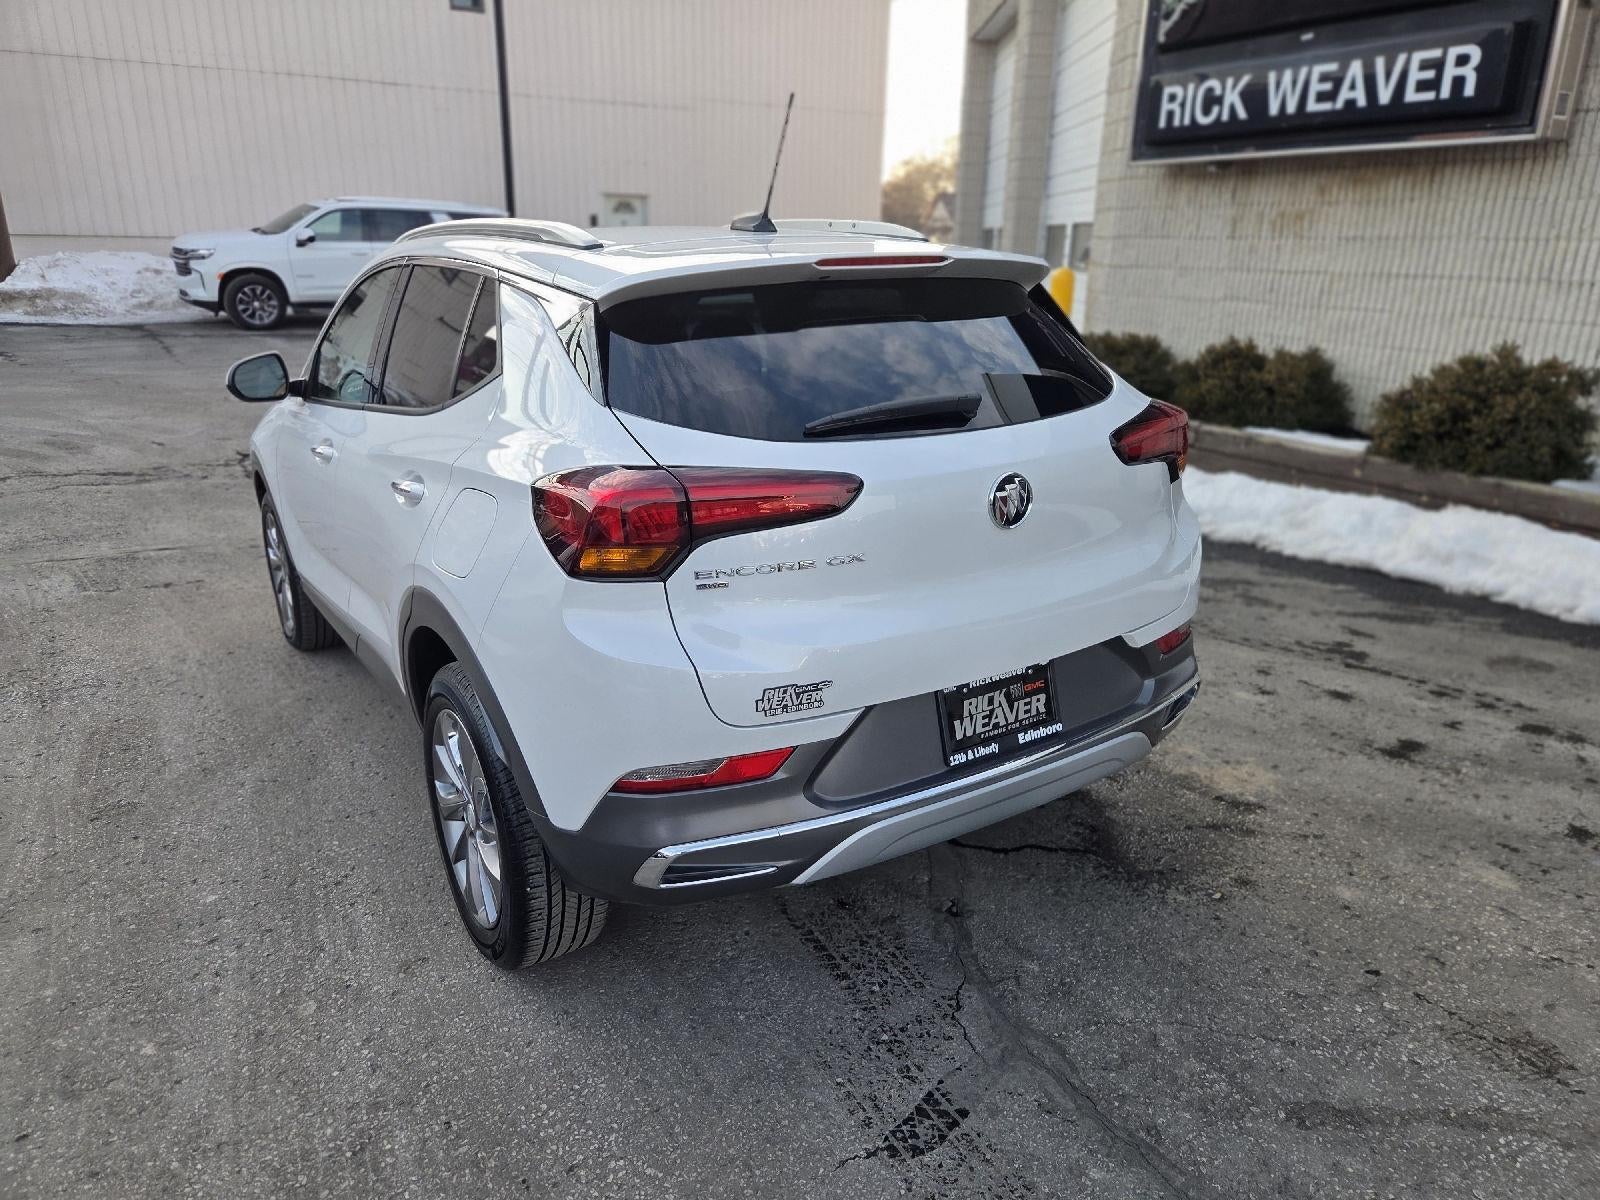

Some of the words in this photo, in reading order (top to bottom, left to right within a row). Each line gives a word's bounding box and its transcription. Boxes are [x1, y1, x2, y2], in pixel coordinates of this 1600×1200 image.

[1158, 74, 1251, 129] RICK
[1266, 43, 1483, 116] WEAVER
[694, 559, 817, 580] ENCORE
[825, 552, 866, 567] GX
[763, 686, 797, 700] RICK
[1024, 680, 1045, 692] GMC
[757, 690, 824, 712] WEAVER
[787, 701, 824, 713] EDINBORO
[963, 689, 1007, 718] RICK
[953, 693, 1047, 740] WEAVER
[981, 726, 1007, 739] FAMOUS
[1008, 721, 1020, 731] FOR
[1022, 714, 1047, 726] SERVICE
[1018, 722, 1063, 744] Edinboro
[950, 752, 967, 766] 12th
[967, 749, 975, 760] &
[975, 743, 999, 760] Liberty
